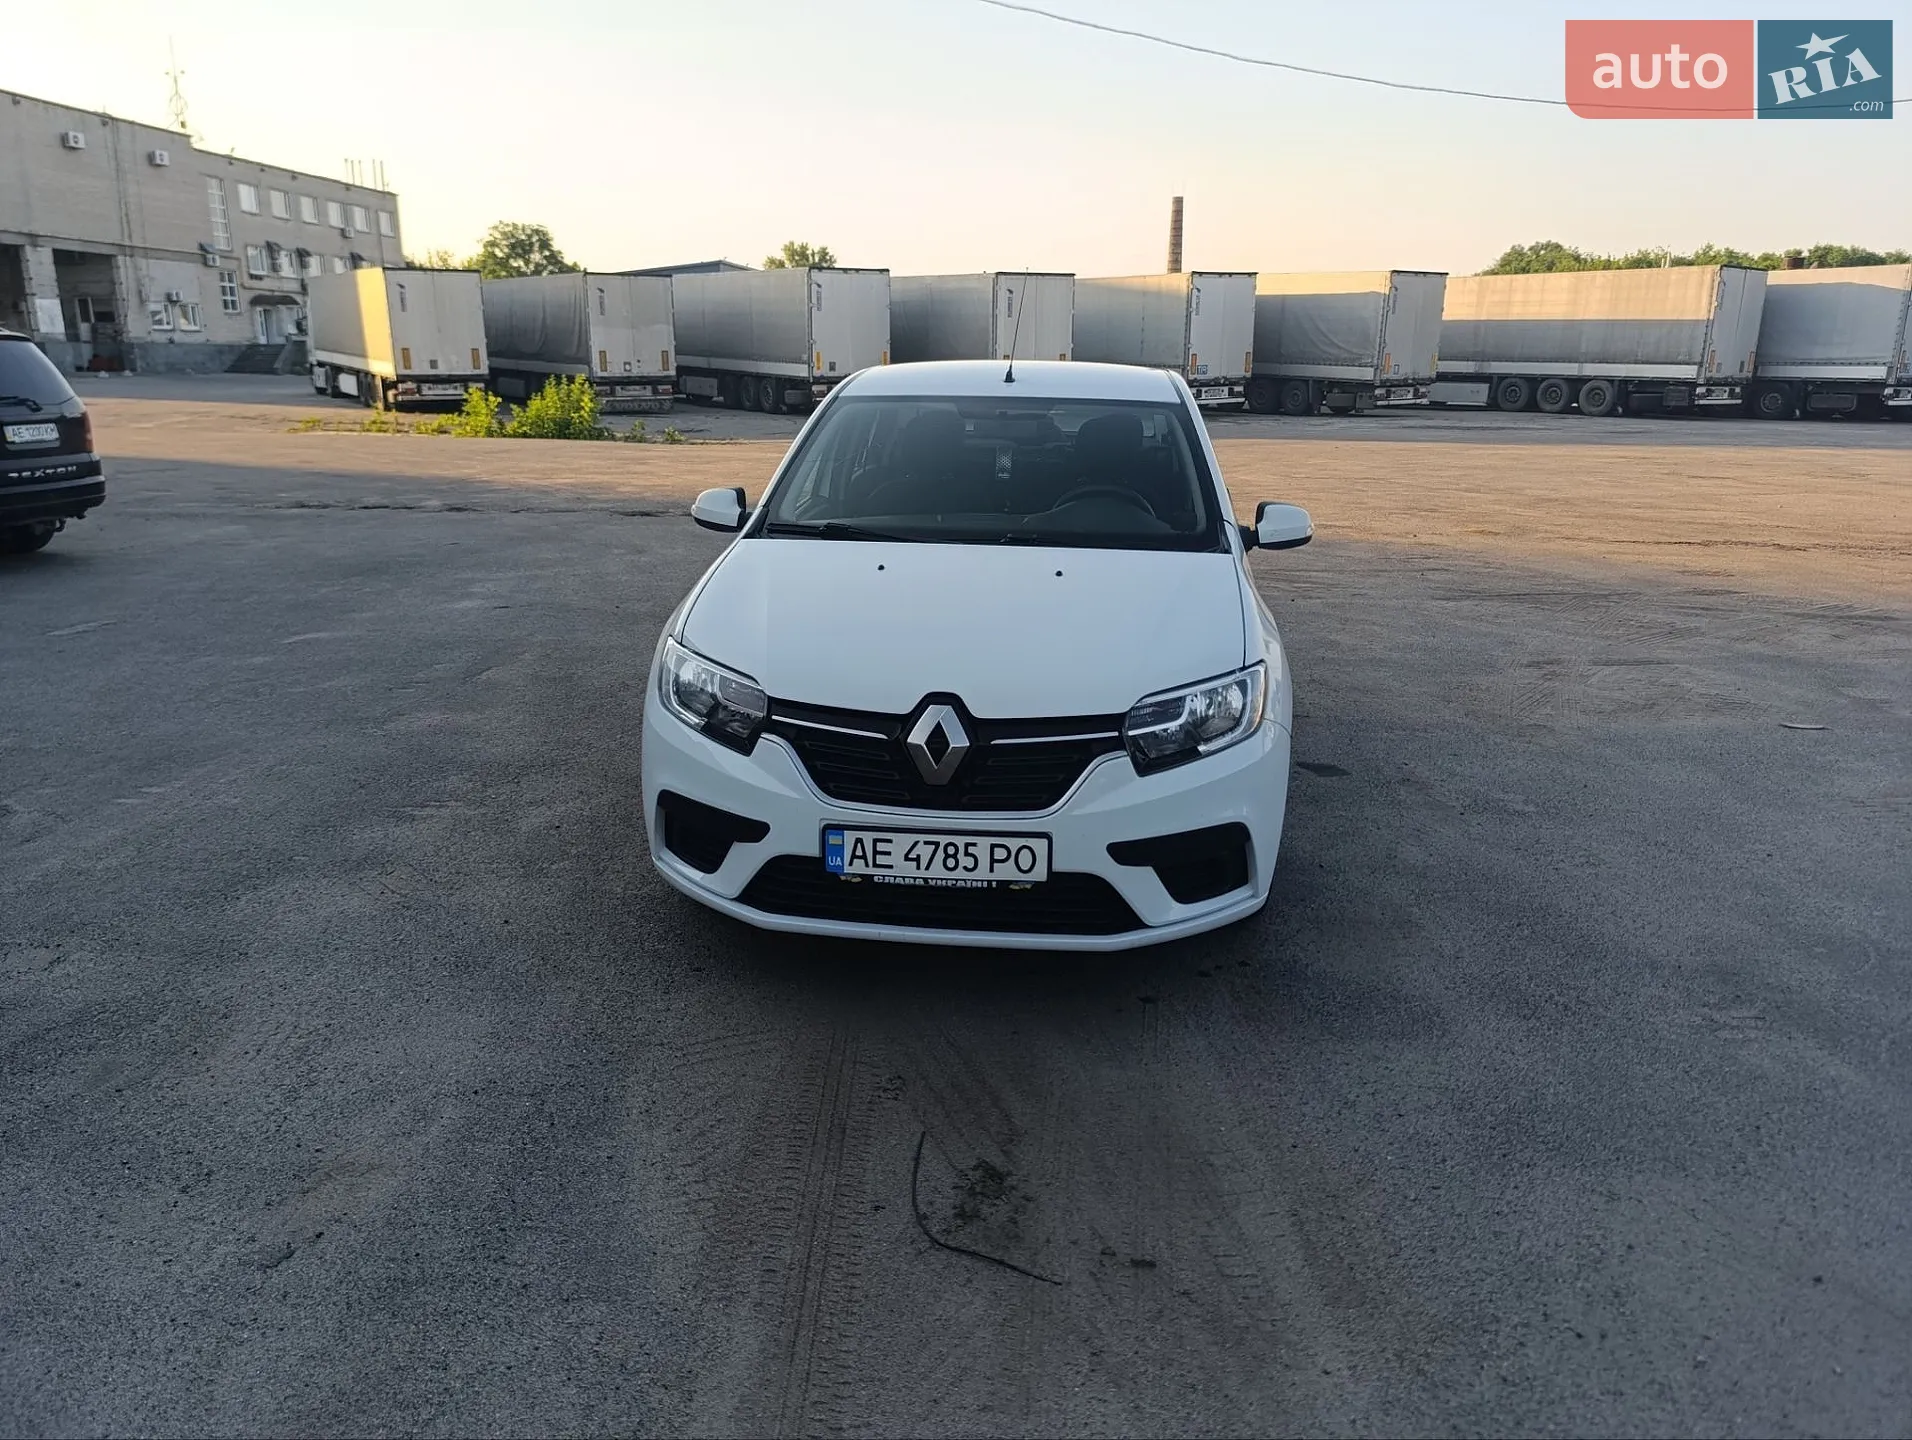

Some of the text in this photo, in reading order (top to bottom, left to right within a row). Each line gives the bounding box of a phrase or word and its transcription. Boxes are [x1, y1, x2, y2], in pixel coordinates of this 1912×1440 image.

[828, 855, 843, 867] UA
[848, 837, 1037, 875] AE 4785 PO
